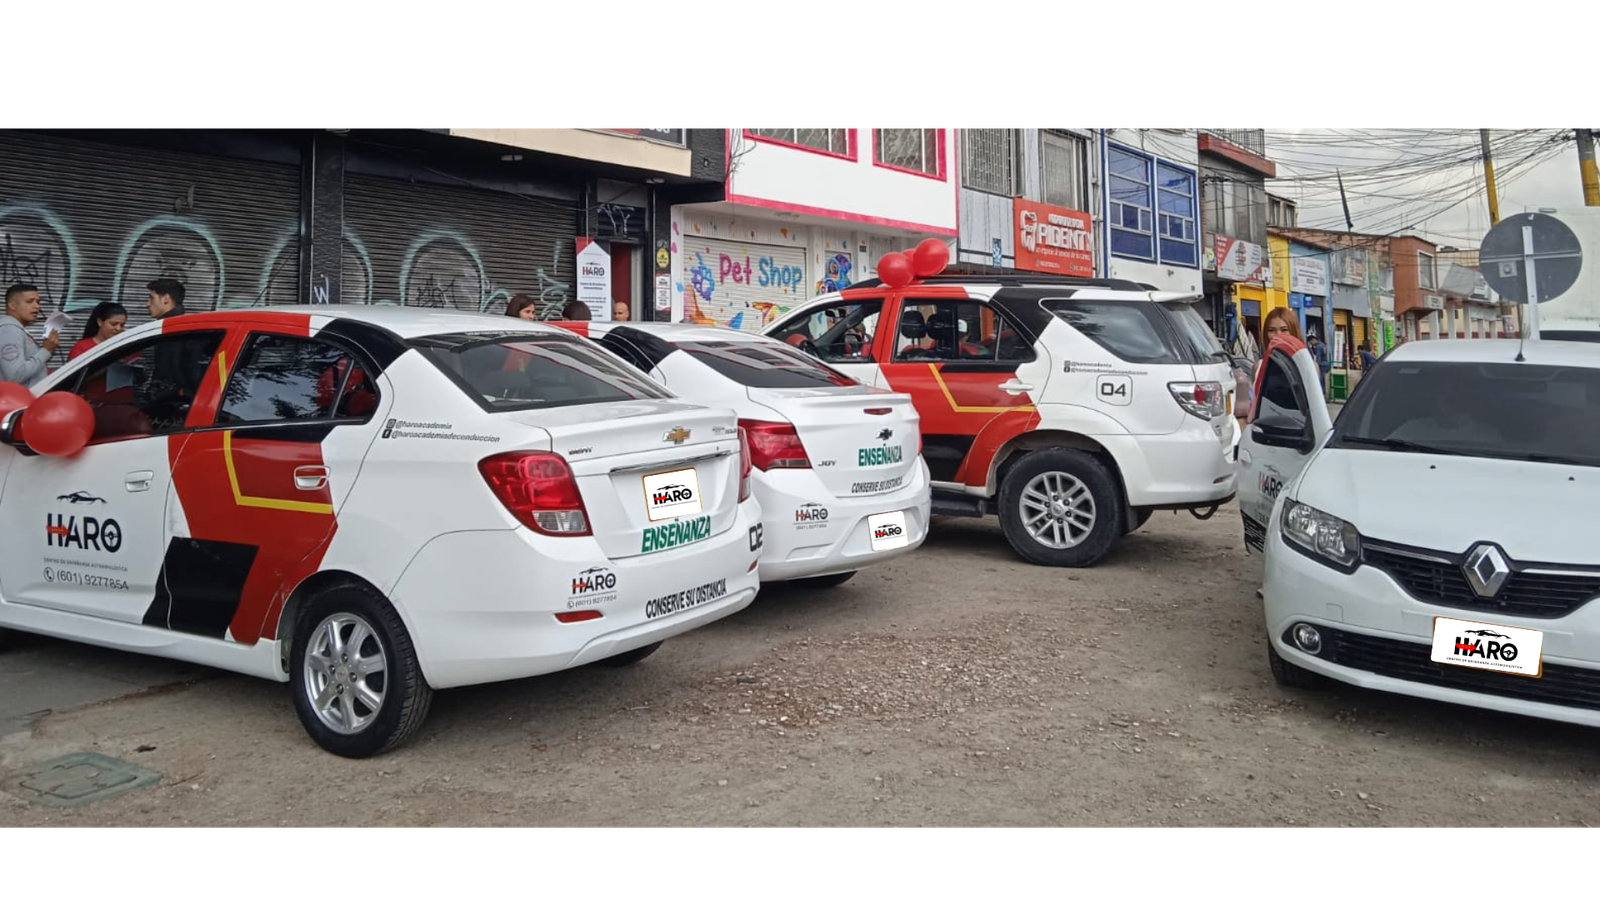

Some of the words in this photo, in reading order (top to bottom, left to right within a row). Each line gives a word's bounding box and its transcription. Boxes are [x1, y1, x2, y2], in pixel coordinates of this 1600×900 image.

[582, 265, 605, 276] HARO
[719, 253, 752, 285] Pet
[758, 256, 803, 293] Shop
[1101, 383, 1126, 397] 04
[858, 443, 902, 467] ENSEÑANZA
[652, 488, 692, 505] HARO
[795, 508, 828, 521] HARO
[46, 513, 122, 553] HARO
[641, 515, 711, 552] ENSEÑANZA
[749, 522, 763, 552] 02
[874, 526, 902, 538] HARO
[57, 570, 82, 586] (601)
[571, 573, 616, 594] HARO
[645, 590, 686, 618] CONSERVE
[686, 587, 696, 607] SU
[696, 577, 728, 604] DISTANCIA
[1454, 637, 1518, 661] HARO
